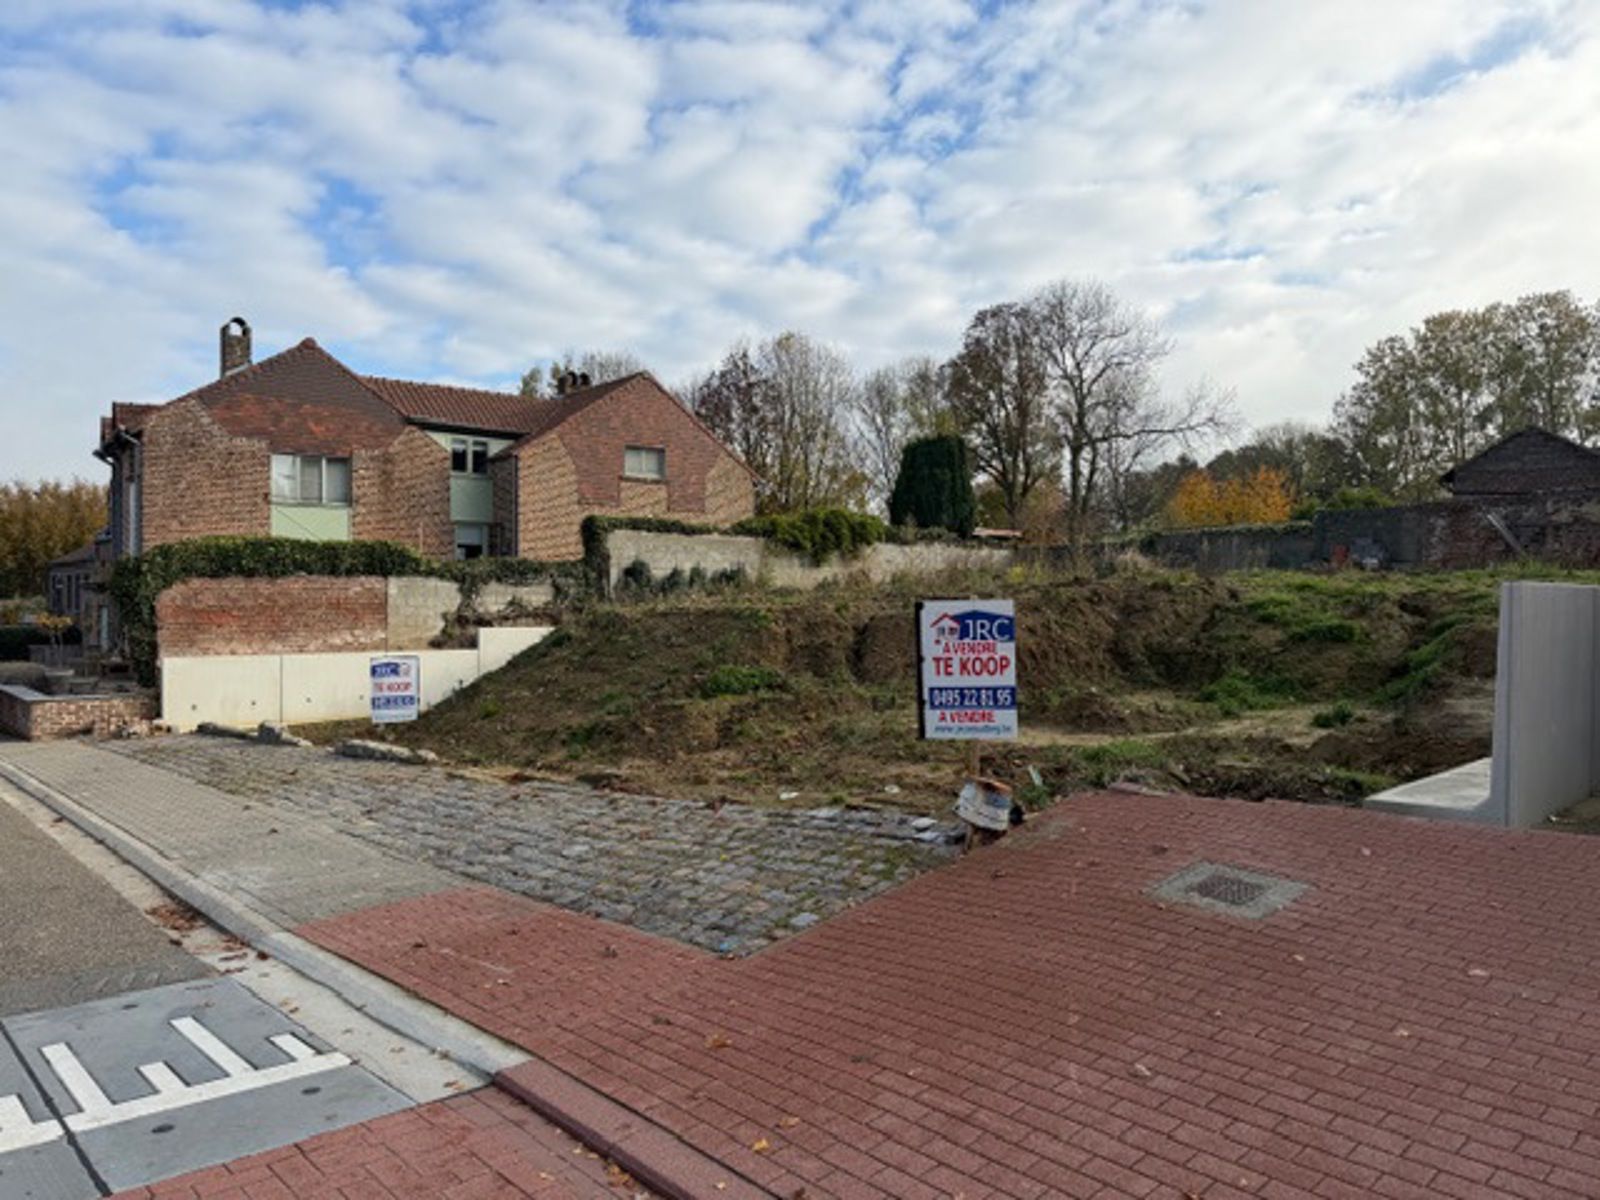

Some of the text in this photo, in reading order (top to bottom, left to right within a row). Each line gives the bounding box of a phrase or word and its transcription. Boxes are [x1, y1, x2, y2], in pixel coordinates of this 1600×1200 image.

[964, 618, 1010, 640] JRC
[953, 641, 997, 655] VENDRE
[932, 655, 1010, 676] TE KOOP
[386, 682, 412, 692] KOOP
[932, 689, 960, 706] 0495
[963, 689, 978, 706] 22
[938, 711, 996, 723] A VENDRE
